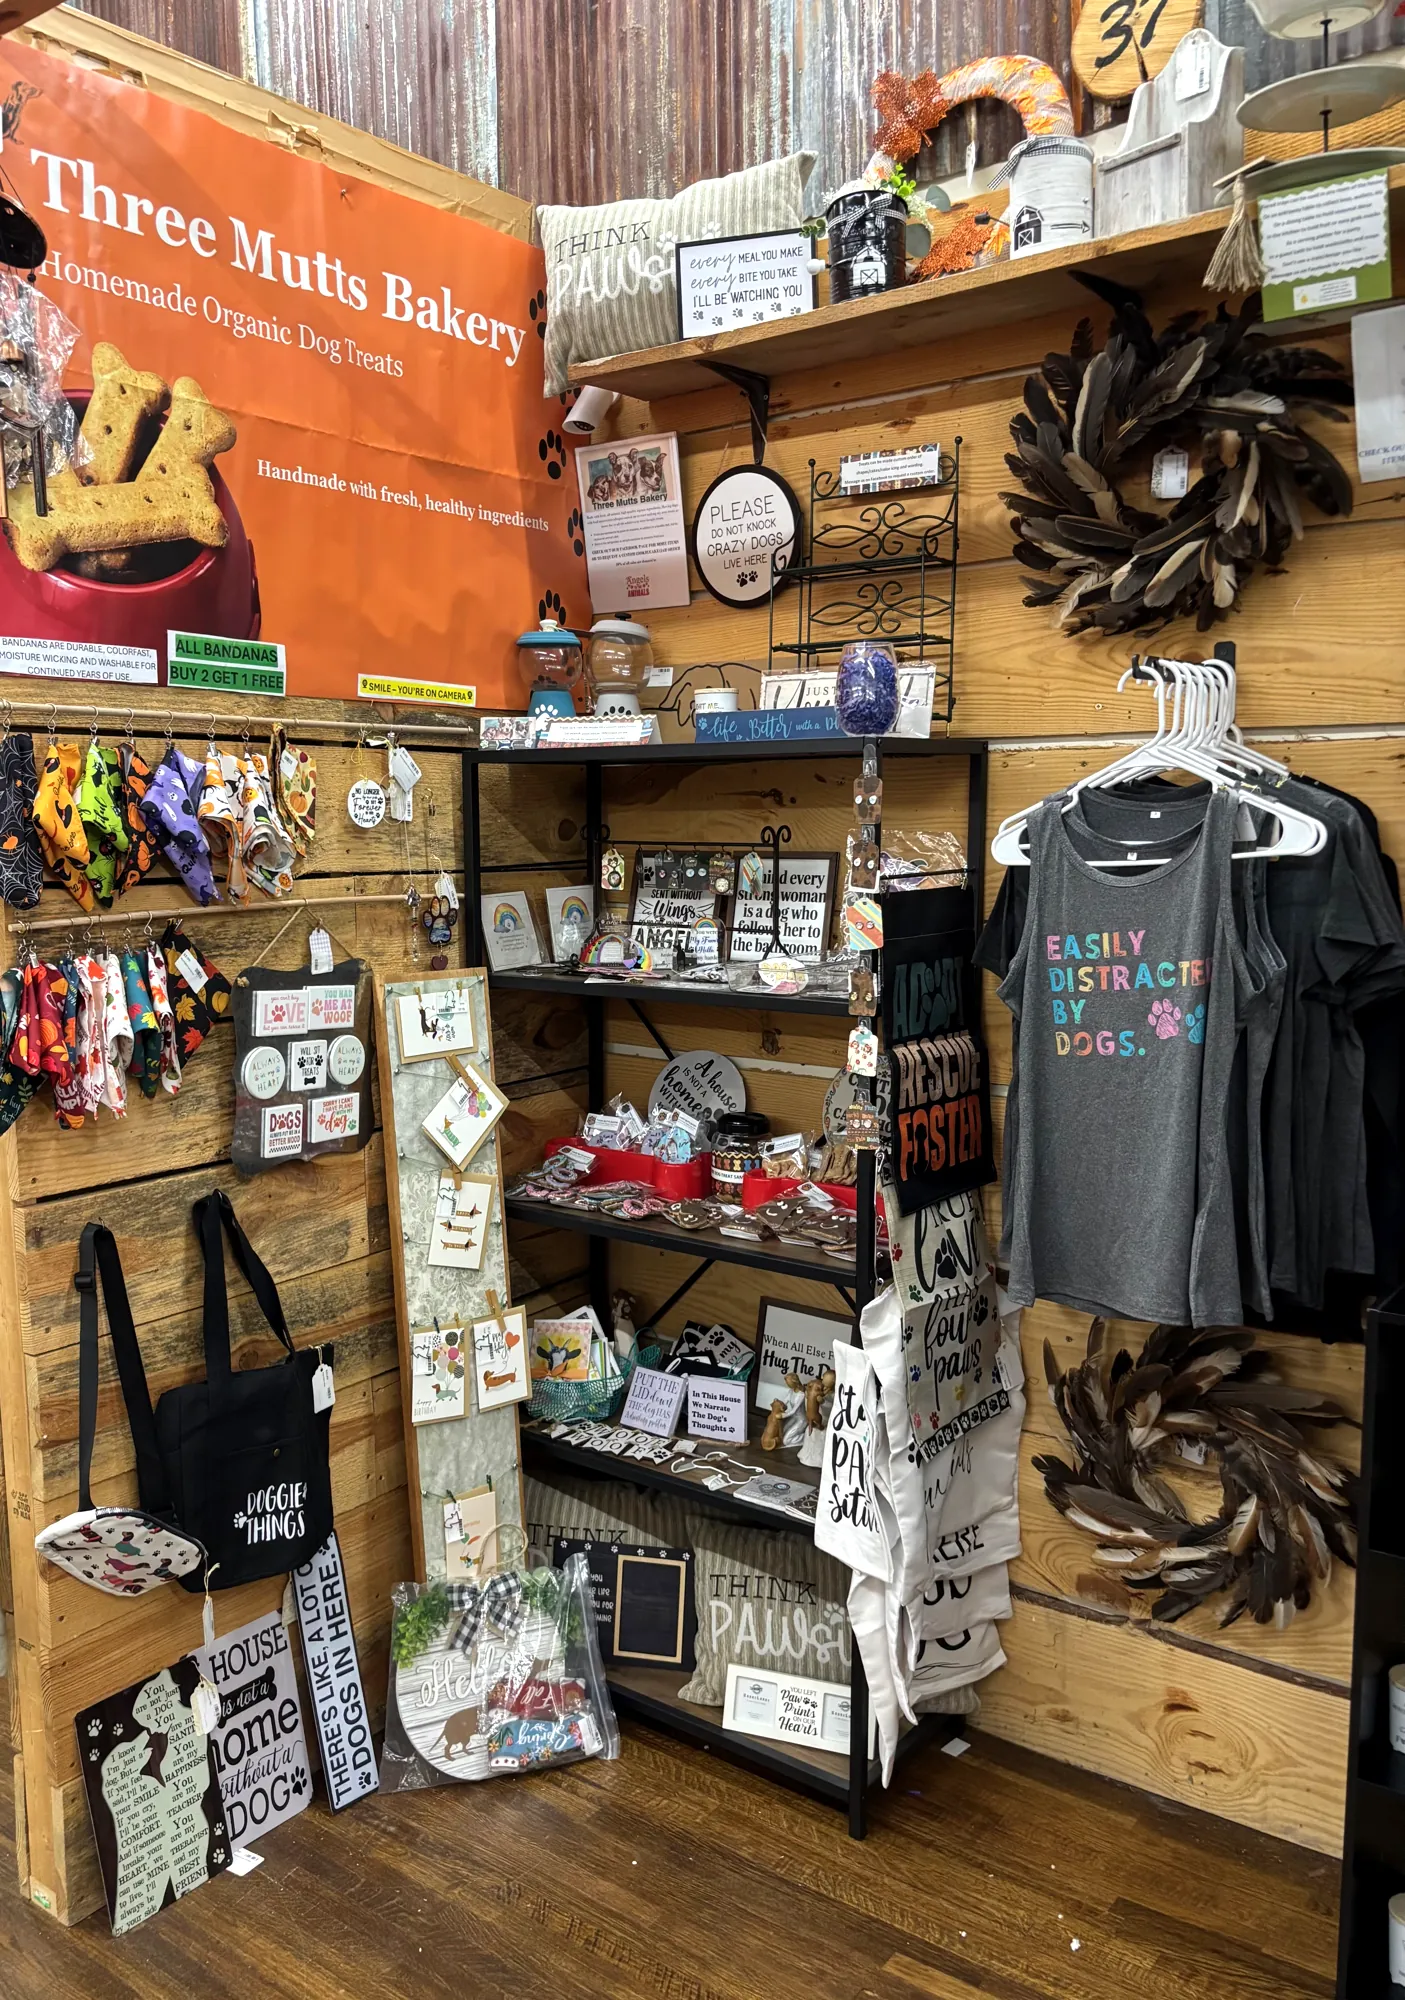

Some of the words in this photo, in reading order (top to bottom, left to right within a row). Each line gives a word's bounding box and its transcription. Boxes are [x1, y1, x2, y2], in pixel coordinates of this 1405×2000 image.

[554, 220, 652, 263] THINK
[31, 148, 217, 257] Three
[229, 216, 366, 311] Mutts
[382, 271, 527, 366] Bakery
[690, 252, 736, 273] every
[738, 253, 761, 264] MEAL
[761, 249, 778, 261] YOU
[779, 246, 804, 259] MAKE
[690, 270, 737, 293] every
[739, 272, 758, 284] BITE
[759, 269, 776, 281] YOU
[776, 267, 798, 279] TAKE
[693, 295, 712, 308] I'LL
[714, 292, 728, 306] BE
[730, 286, 780, 303] WATCHING
[783, 284, 803, 298] YOU
[39, 250, 197, 316] Homemade
[203, 295, 292, 344] Organic
[298, 323, 341, 364] Dog
[344, 337, 404, 377] Treats
[257, 459, 347, 492] Handmade
[350, 480, 377, 500] with
[380, 485, 422, 511] fresh,
[425, 494, 475, 521] healthy
[478, 504, 549, 531] ingredients
[592, 500, 614, 511] Three
[616, 497, 638, 507] Mutts
[640, 493, 668, 503] Bakery
[710, 495, 774, 525] PLEASE
[711, 527, 724, 539] DO
[726, 523, 744, 536] NOT
[746, 518, 776, 534] KNOCK
[707, 540, 747, 557] CRAZY
[751, 532, 783, 549] DOGS
[723, 557, 742, 570] LIVE
[744, 553, 768, 566] HERE
[2, 638, 48, 649] BANDANAS
[49, 641, 65, 650] ARE
[66, 642, 105, 654] DURABLE,
[106, 646, 152, 658] COLORFAST,
[175, 639, 201, 656] ALL
[204, 639, 278, 663] BANDANAS
[0, 651, 41, 662] MOISTURE
[42, 654, 78, 665] WICKING
[79, 656, 97, 666] AND
[99, 658, 139, 669] WASHABLE
[140, 661, 156, 670] FOR
[27, 666, 75, 677] CONTINUED
[76, 669, 101, 679] YEARS
[102, 671, 114, 680] OF
[114, 672, 132, 681] USE.
[170, 665, 197, 681] BUY
[201, 668, 209, 682] 2
[212, 669, 239, 685] GET
[241, 672, 249, 686] 1
[252, 672, 284, 690] FREE
[368, 682, 391, 694] SMILE
[397, 685, 425, 697] YOU'RE
[426, 688, 437, 698] ON
[437, 690, 467, 701] CAMERA
[806, 686, 838, 696] JUST
[708, 715, 738, 741] life
[748, 713, 792, 740] Better
[795, 721, 814, 731] with
[789, 874, 826, 889] every
[651, 889, 669, 899] SENT
[670, 890, 703, 900] WITHOUT
[781, 891, 826, 903] woman
[653, 899, 696, 921] Wings
[743, 903, 754, 918] is
[756, 907, 763, 918] a
[791, 905, 818, 920] who
[783, 922, 806, 938] her
[807, 925, 821, 938] to
[733, 937, 753, 952] the
[1046, 930, 1146, 960] EASILY
[324, 990, 337, 999] YOU
[339, 989, 353, 998] HAD
[324, 999, 338, 1011] ME
[340, 998, 353, 1010] AT
[263, 1003, 306, 1024] LVE
[323, 1011, 353, 1024] WOOF
[1052, 999, 1086, 1024] BY
[300, 1046, 311, 1055] WILL
[1055, 1030, 1146, 1057] DOGS.
[252, 1054, 281, 1071] ALWAYS
[893, 1030, 981, 1109] RESCUE
[257, 1077, 280, 1092] HEART
[663, 1065, 702, 1112] home
[682, 1067, 691, 1076] IS
[689, 1075, 704, 1091] NOT
[700, 1090, 708, 1098] A
[694, 1059, 714, 1078] A
[707, 1071, 738, 1112] house
[898, 1094, 982, 1181] FOSTER
[763, 1334, 789, 1349] When
[790, 1342, 804, 1354] All
[806, 1346, 826, 1359] Else
[762, 1348, 789, 1375] Hug
[790, 1356, 814, 1377] The
[933, 1338, 982, 1411] paws
[631, 1384, 650, 1400] LID
[635, 1371, 658, 1388] PUT
[658, 1377, 680, 1395] THE
[692, 1390, 700, 1398] In
[701, 1391, 717, 1400] This
[719, 1394, 742, 1404] House
[692, 1400, 703, 1409] We
[703, 1402, 731, 1412] Narrate
[692, 1411, 706, 1419] The
[707, 1412, 728, 1423] Dog's
[692, 1421, 727, 1433] Thoughts
[247, 1482, 304, 1516] DOGGIE
[246, 1510, 306, 1545] THINGS
[319, 1553, 349, 1643] HERE.
[709, 1574, 817, 1605] THINK
[300, 1583, 321, 1626] LOT
[307, 1630, 325, 1643] A
[208, 1624, 288, 1685] HOUSE
[332, 1646, 354, 1673] IN
[311, 1646, 336, 1703] LIKE,
[143, 1683, 166, 1700] You
[221, 1700, 235, 1717] is
[236, 1681, 261, 1708] not
[260, 1681, 270, 1695] a
[780, 1689, 803, 1703] Paw
[790, 1686, 802, 1694] YOU
[803, 1689, 818, 1697] LEFT
[154, 1700, 173, 1717] DOG
[783, 1701, 816, 1719] Prints
[339, 1681, 372, 1770] DOGS
[517, 1722, 572, 1749] Spring
[778, 1716, 818, 1736] Hearts
[321, 1705, 353, 1805] THERE'S
[164, 1753, 207, 1783] HAPPINESS
[133, 1786, 160, 1807] SMILE
[166, 1792, 203, 1818] TEACHER
[226, 1771, 289, 1842] DOG
[120, 1820, 163, 1849] COMFORT.
[170, 1827, 209, 1856] THERAPIST
[146, 1861, 170, 1880] MINE
[178, 1856, 201, 1877] BEST
